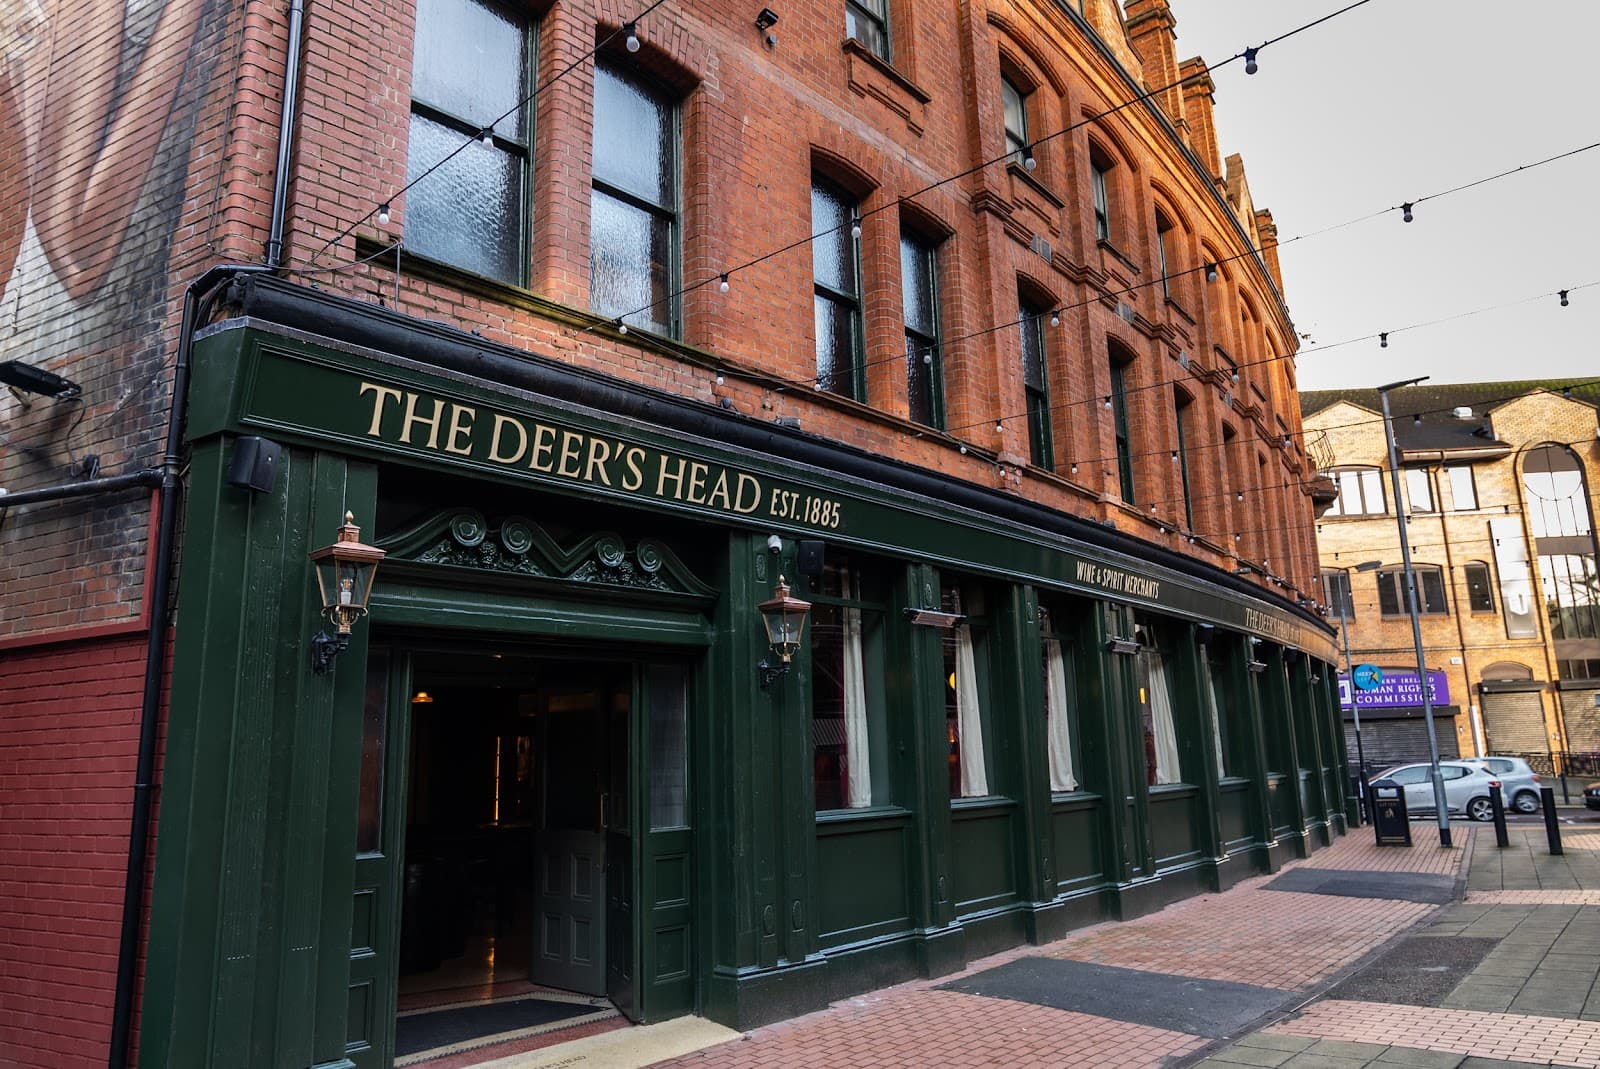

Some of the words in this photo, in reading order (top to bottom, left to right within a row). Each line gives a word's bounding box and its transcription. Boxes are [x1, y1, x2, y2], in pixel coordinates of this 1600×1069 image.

[359, 382, 476, 456] THE
[488, 414, 646, 491] DEER'S
[656, 454, 762, 514] HEAD
[770, 488, 800, 521] EST.
[804, 496, 841, 529] 1885
[1077, 561, 1096, 584] WINE
[1096, 569, 1101, 583] &
[1102, 568, 1124, 591] SPIRIT
[1125, 574, 1159, 599] MERCHANTS
[1246, 607, 1258, 629] THE
[1398, 684, 1435, 693] RIGHS
